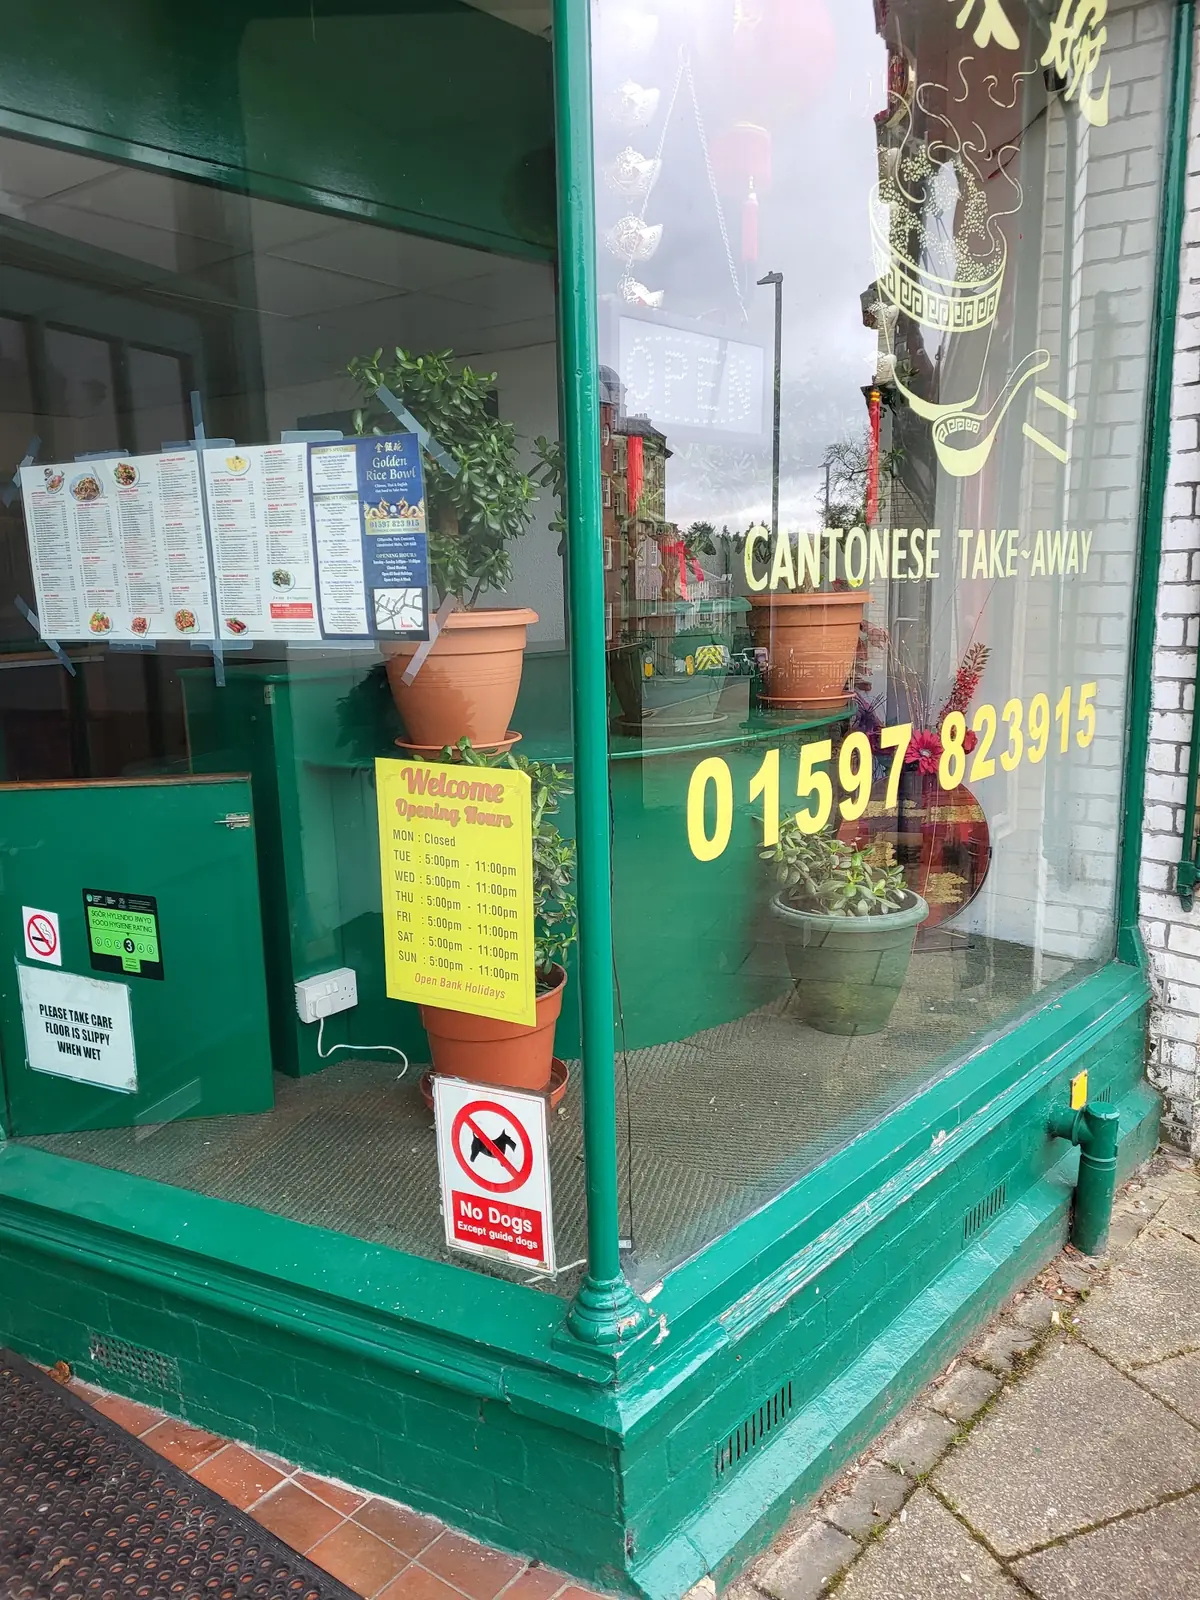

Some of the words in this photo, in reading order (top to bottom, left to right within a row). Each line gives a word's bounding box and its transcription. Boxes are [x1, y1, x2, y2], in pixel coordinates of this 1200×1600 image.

[626, 345, 752, 416] OPEN
[366, 470, 387, 481] Rice
[389, 466, 417, 480] Bowl
[372, 455, 408, 468] Golden
[370, 520, 390, 528] 01597
[392, 520, 405, 528] 823
[406, 519, 420, 527] 915
[744, 526, 941, 591] CANTONESE
[400, 767, 504, 803] Welcome
[686, 722, 913, 862] 01597
[938, 682, 1097, 791] 823915
[395, 798, 461, 827] Opening
[464, 806, 513, 828] Hours
[392, 829, 414, 842] MON
[424, 832, 456, 847] Closed
[394, 850, 411, 862] TUE
[425, 854, 459, 869] 5:00pm
[475, 860, 516, 876] 11:00pm
[394, 870, 415, 883] WED
[426, 874, 460, 890] 5:00pm
[476, 882, 517, 897] 11:00pm
[396, 890, 414, 903] THU
[427, 895, 461, 910] 5:00pm
[477, 904, 517, 919] 11:00pm
[92, 919, 108, 927] FOOD
[109, 921, 132, 930] HYGIENE
[132, 925, 152, 933] RATING
[396, 911, 411, 923] FRI
[428, 916, 462, 931] 5:00pm
[478, 925, 518, 940] 11:00pm
[126, 940, 132, 952] 3
[397, 930, 414, 943] SAT
[428, 936, 462, 951] 5:00pm
[478, 945, 518, 960] 11:00pm
[398, 950, 417, 964] SUN
[430, 956, 463, 972] 5:00pm
[479, 965, 519, 981] 11:00pm
[414, 972, 437, 986] Open
[440, 978, 462, 991] Bank
[465, 981, 506, 999] Holidays
[39, 1004, 68, 1020] PLEASE
[69, 1010, 90, 1025] TAKE
[91, 1014, 113, 1030] CARE
[45, 1022, 70, 1038] FLOOR
[72, 1028, 80, 1040] IS
[82, 1029, 110, 1046] SLIPPY
[57, 1041, 82, 1057] WHEN
[83, 1047, 101, 1061] WET
[460, 1200, 483, 1220] No
[488, 1206, 532, 1234] Dogs
[458, 1221, 486, 1236] Except
[488, 1229, 514, 1243] guide
[516, 1235, 538, 1250] dogs
